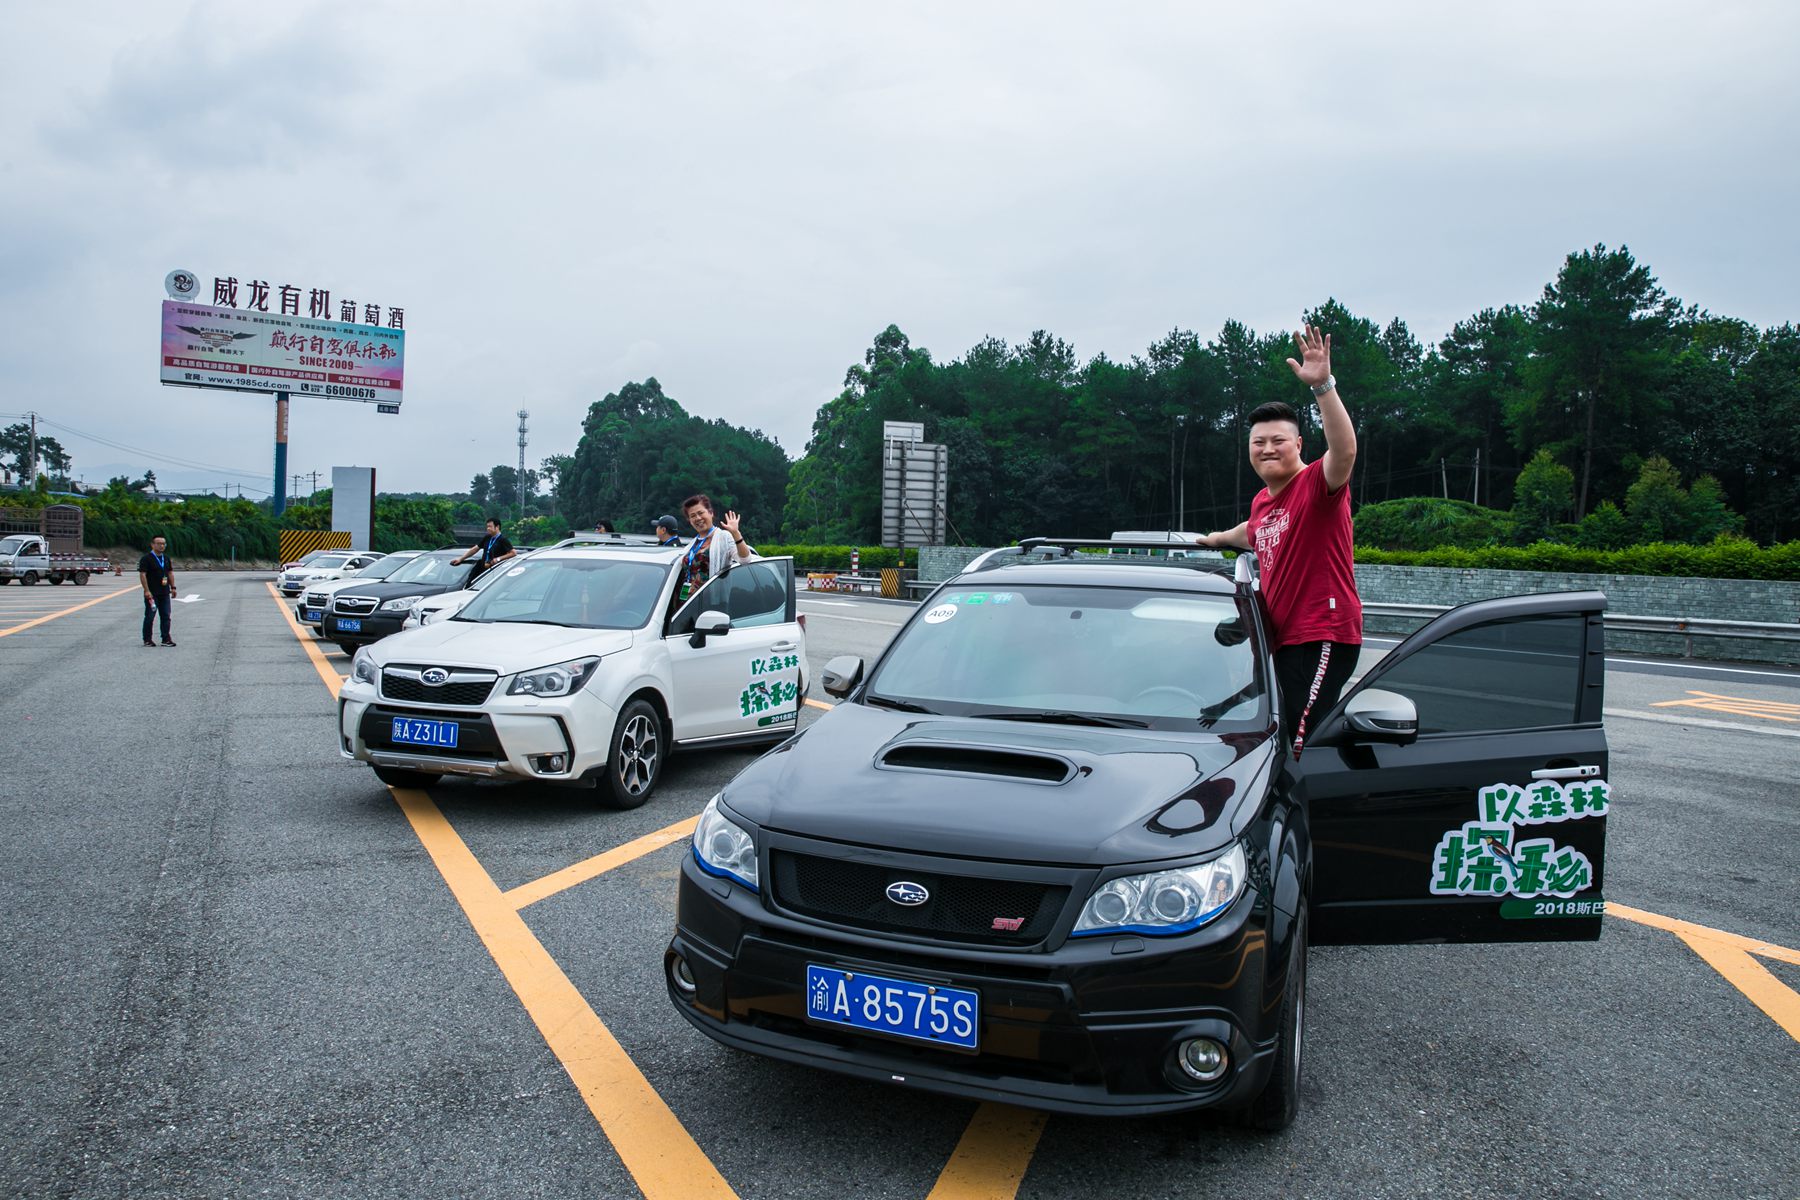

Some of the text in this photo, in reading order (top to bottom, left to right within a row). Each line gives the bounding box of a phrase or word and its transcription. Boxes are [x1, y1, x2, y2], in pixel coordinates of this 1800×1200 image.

[213, 277, 404, 329] 威龙有机葡萄酒
[299, 355, 354, 370] SINCE 2009
[208, 375, 291, 390] www.1985cd.com
[326, 384, 376, 399] 66000676
[751, 654, 800, 675] 以森林
[1484, 784, 1609, 823] 以森林
[1436, 827, 1588, 894] 探秘
